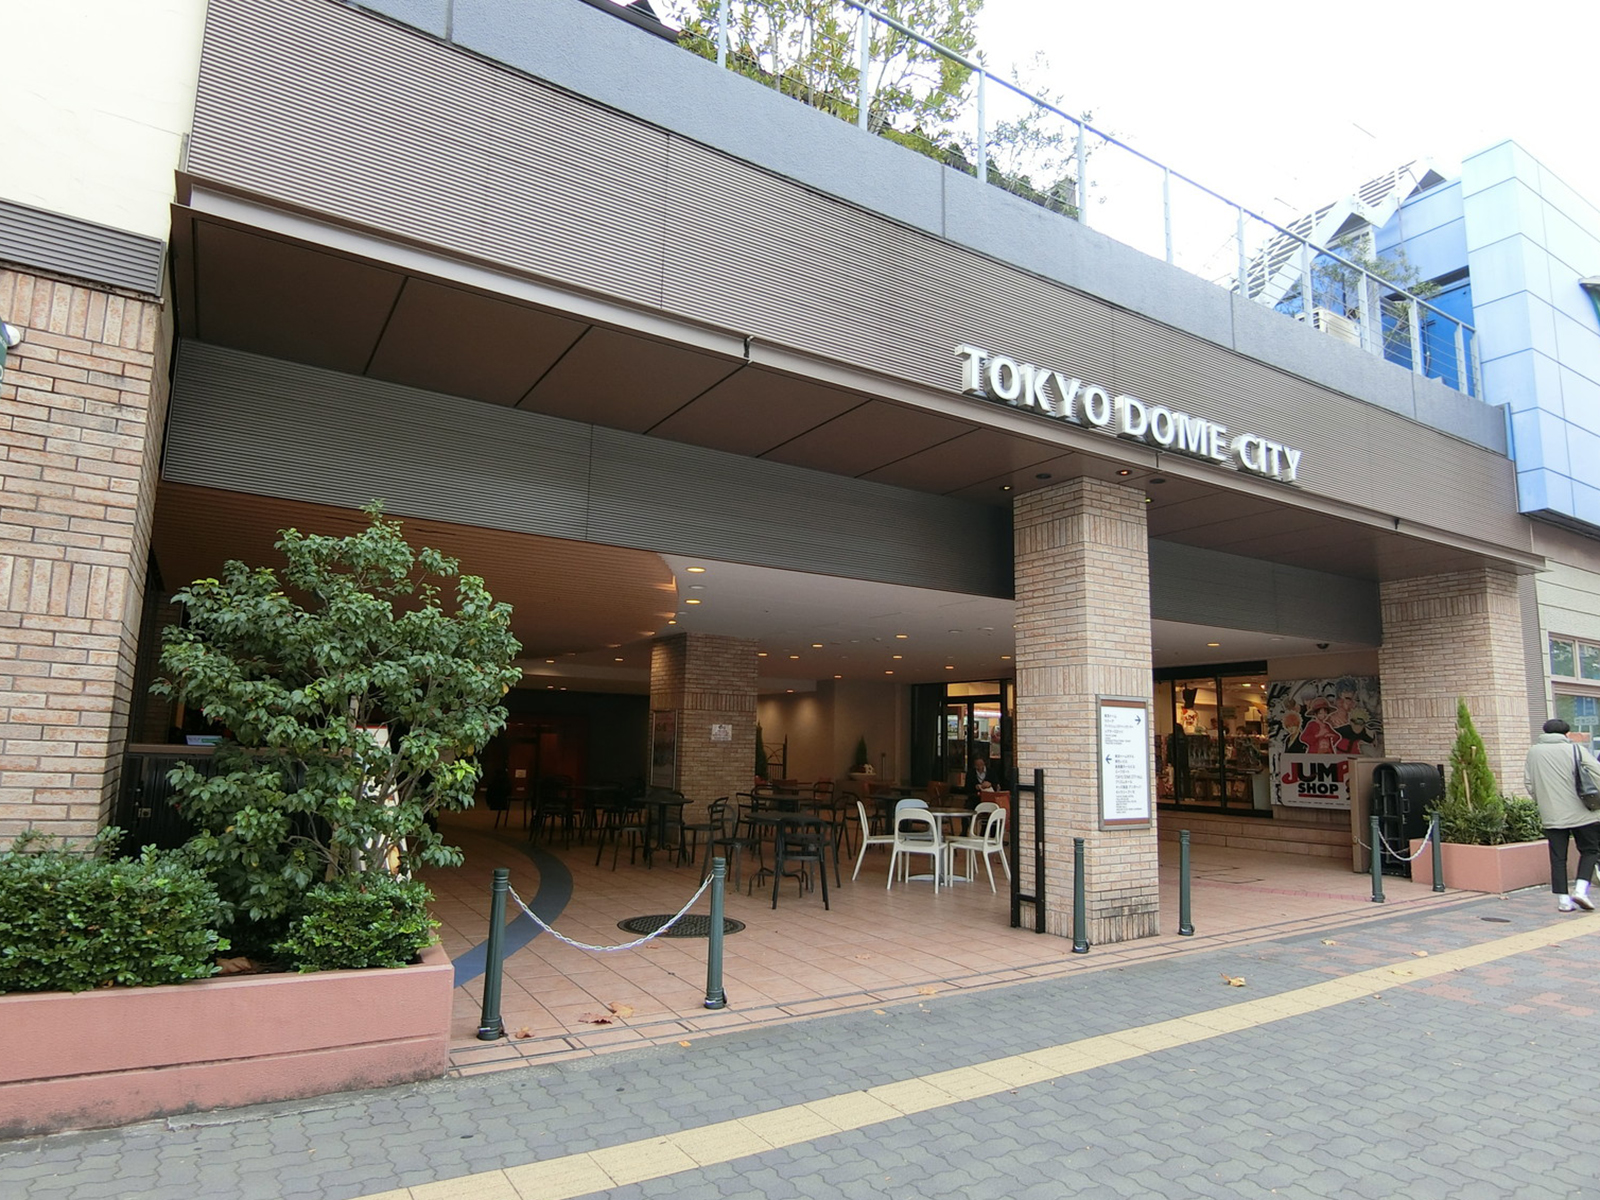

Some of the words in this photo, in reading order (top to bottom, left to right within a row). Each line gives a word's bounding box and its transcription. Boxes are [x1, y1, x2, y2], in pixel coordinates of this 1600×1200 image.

[955, 343, 1112, 428] TOKYO
[1116, 395, 1227, 464] DOME
[1231, 433, 1302, 482] CITY
[1282, 761, 1349, 784] JUMP
[1298, 783, 1339, 794] SHOP
